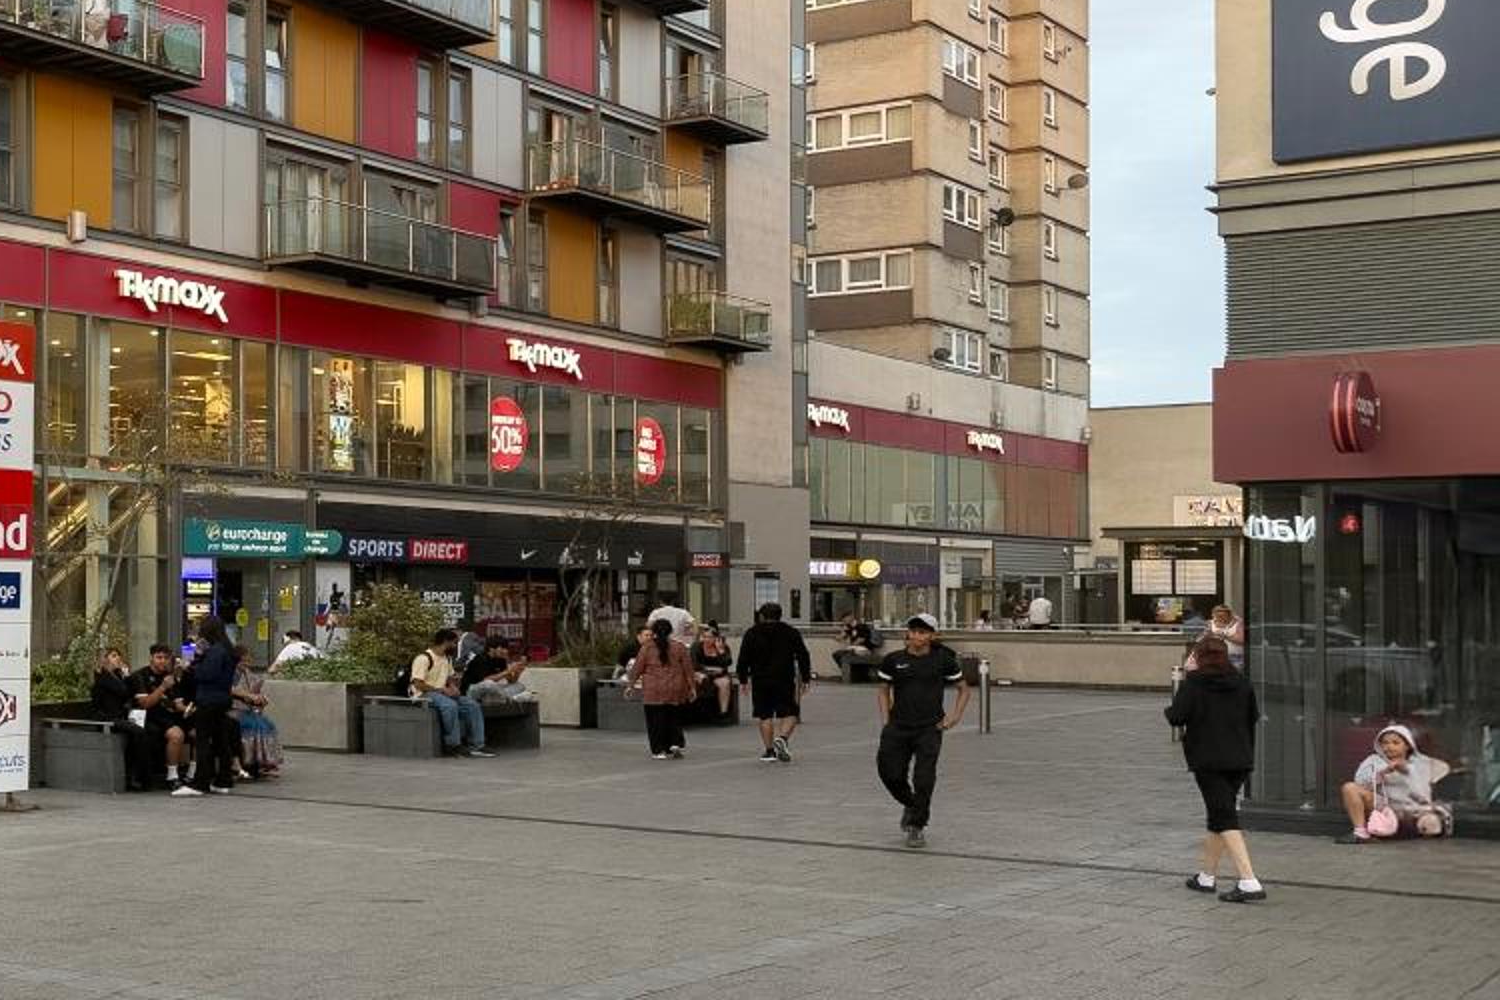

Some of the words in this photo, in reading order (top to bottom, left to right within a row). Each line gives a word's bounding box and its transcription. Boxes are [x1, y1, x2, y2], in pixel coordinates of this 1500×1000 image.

[222, 527, 288, 545] eurochange
[348, 539, 404, 558] SPORTS
[412, 541, 466, 560] DIRECT
